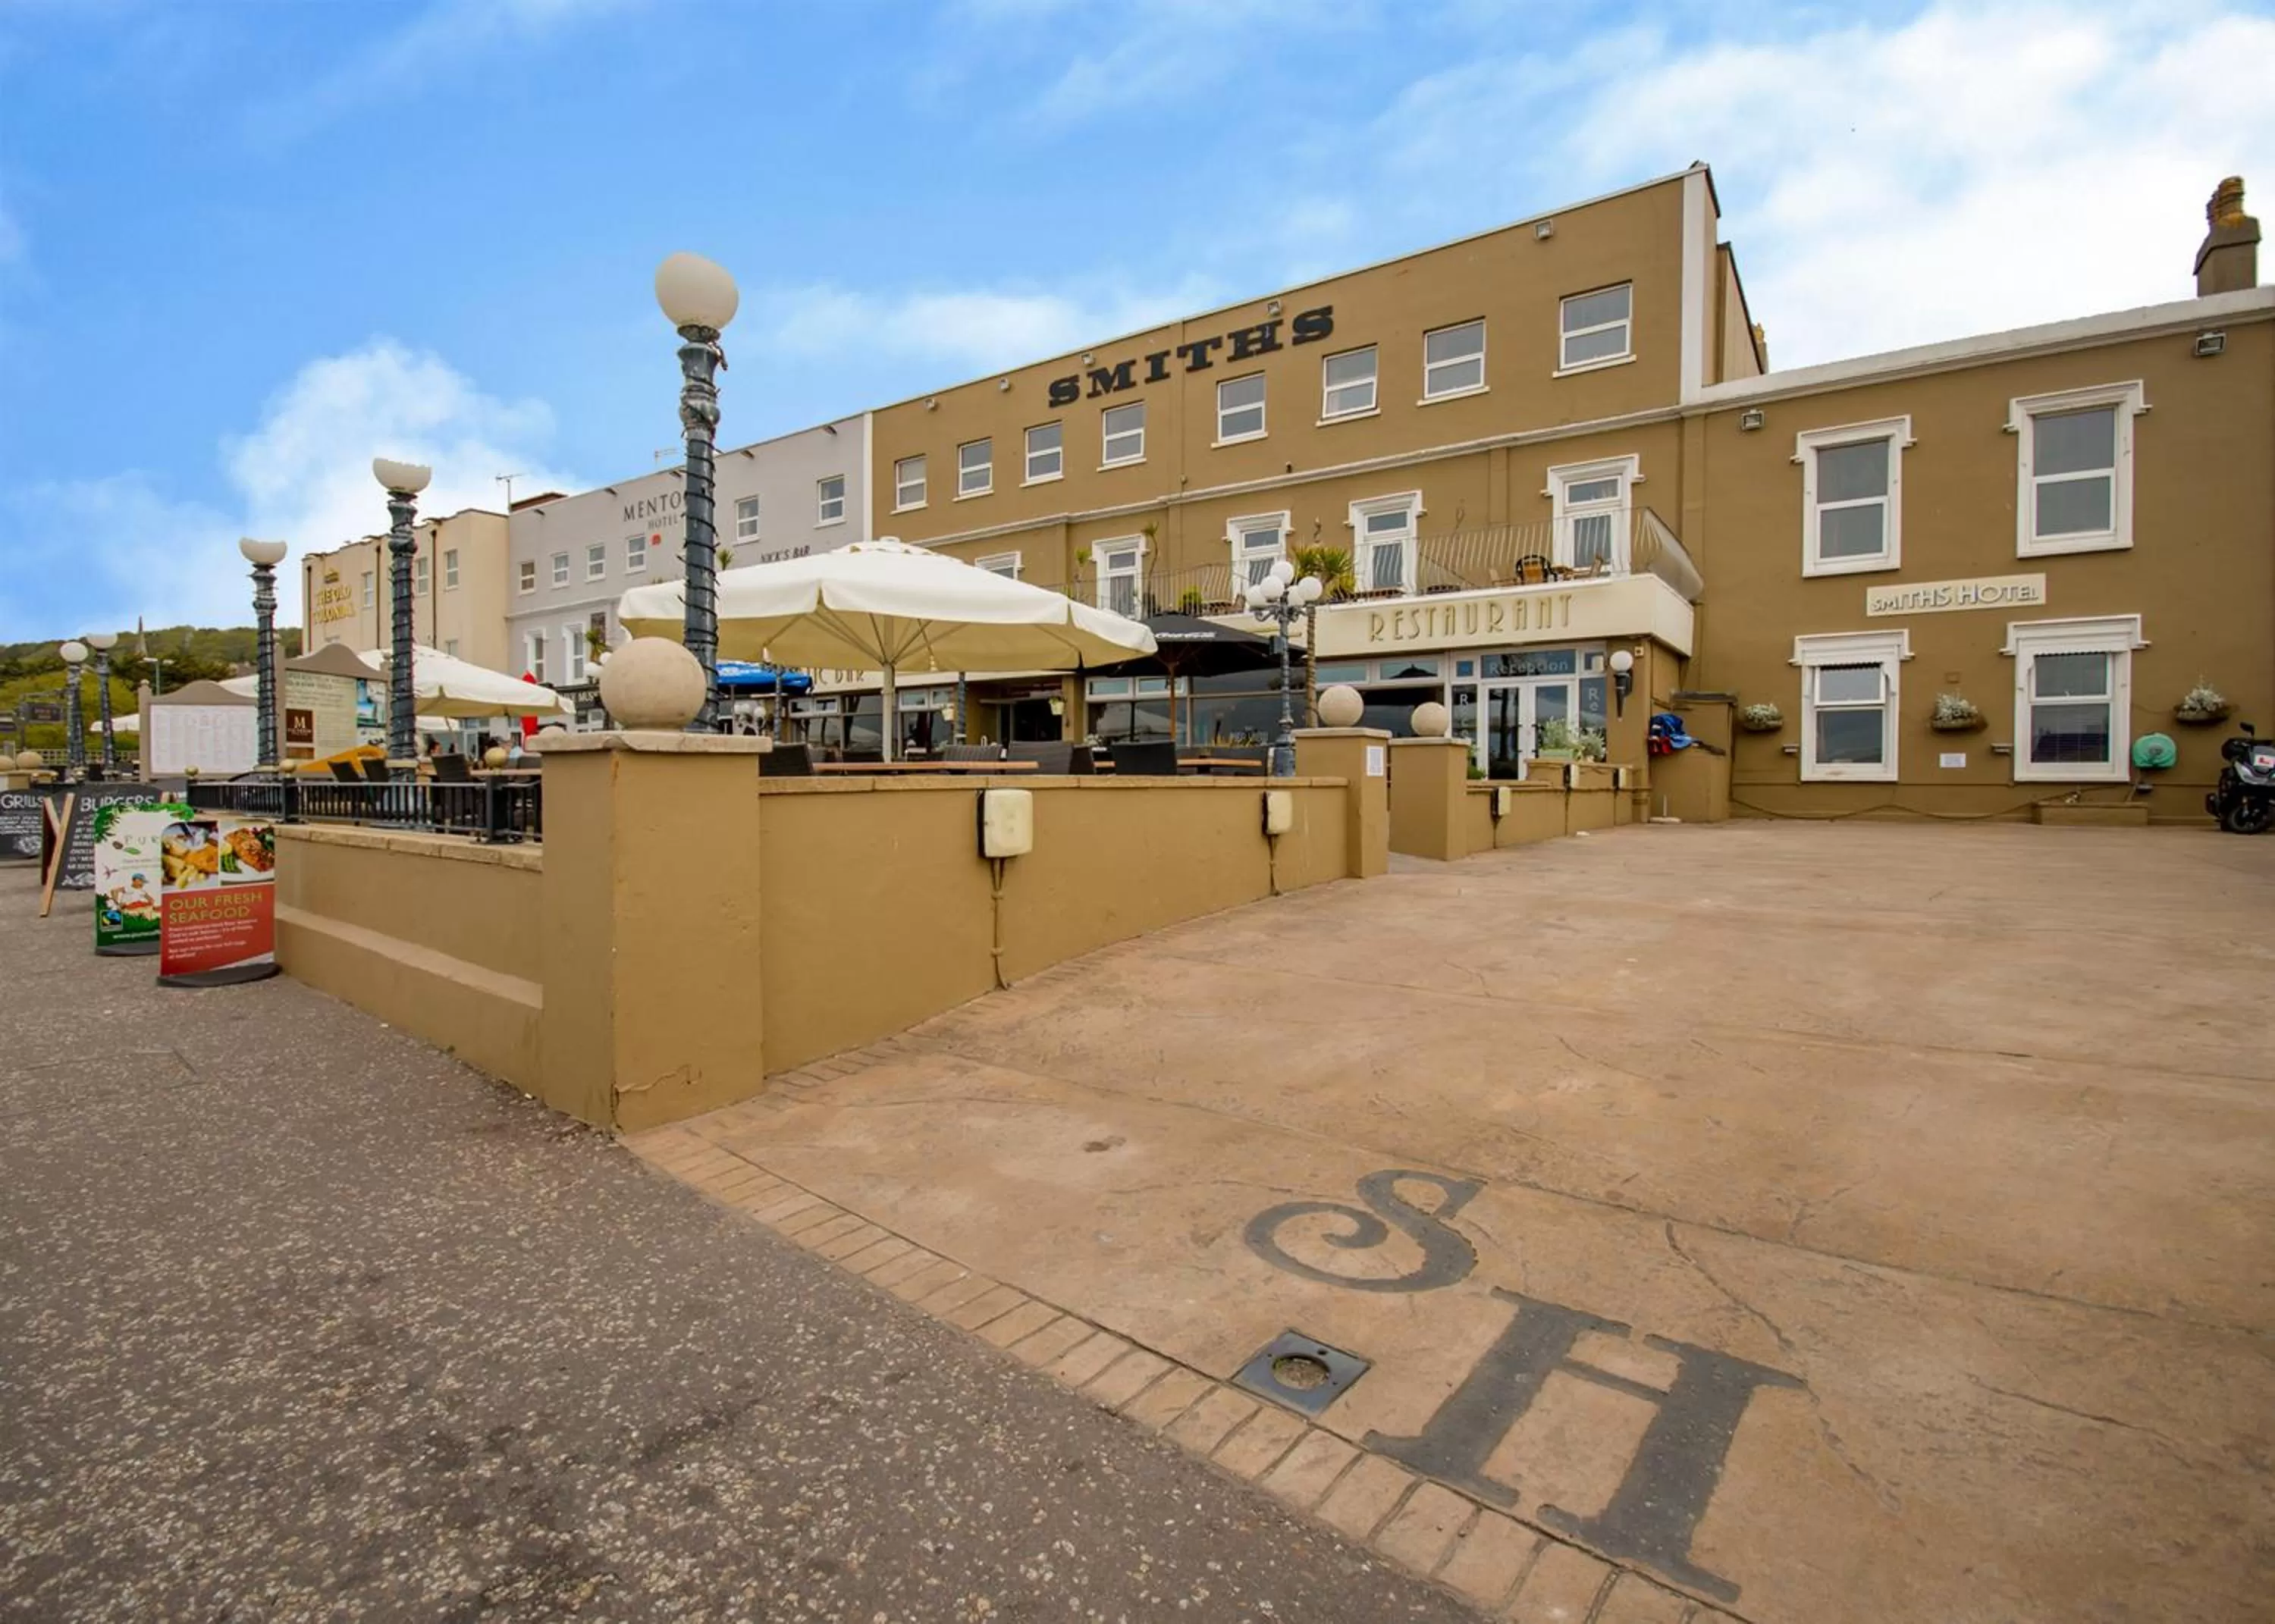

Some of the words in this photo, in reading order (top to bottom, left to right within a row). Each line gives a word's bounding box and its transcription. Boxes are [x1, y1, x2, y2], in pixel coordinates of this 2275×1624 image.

[1049, 306, 1333, 408] SMITHS
[623, 491, 681, 522] MENTO
[648, 516, 678, 530] HOTEL
[1872, 586, 1952, 613] SMITHS
[1958, 583, 2038, 607] HOTEL
[1370, 594, 1572, 642] RESTAURANT
[1489, 660, 1568, 675] Reception
[169, 897, 208, 911] OUR
[214, 891, 263, 908] FRESH
[169, 905, 251, 925] SEAFOOD
